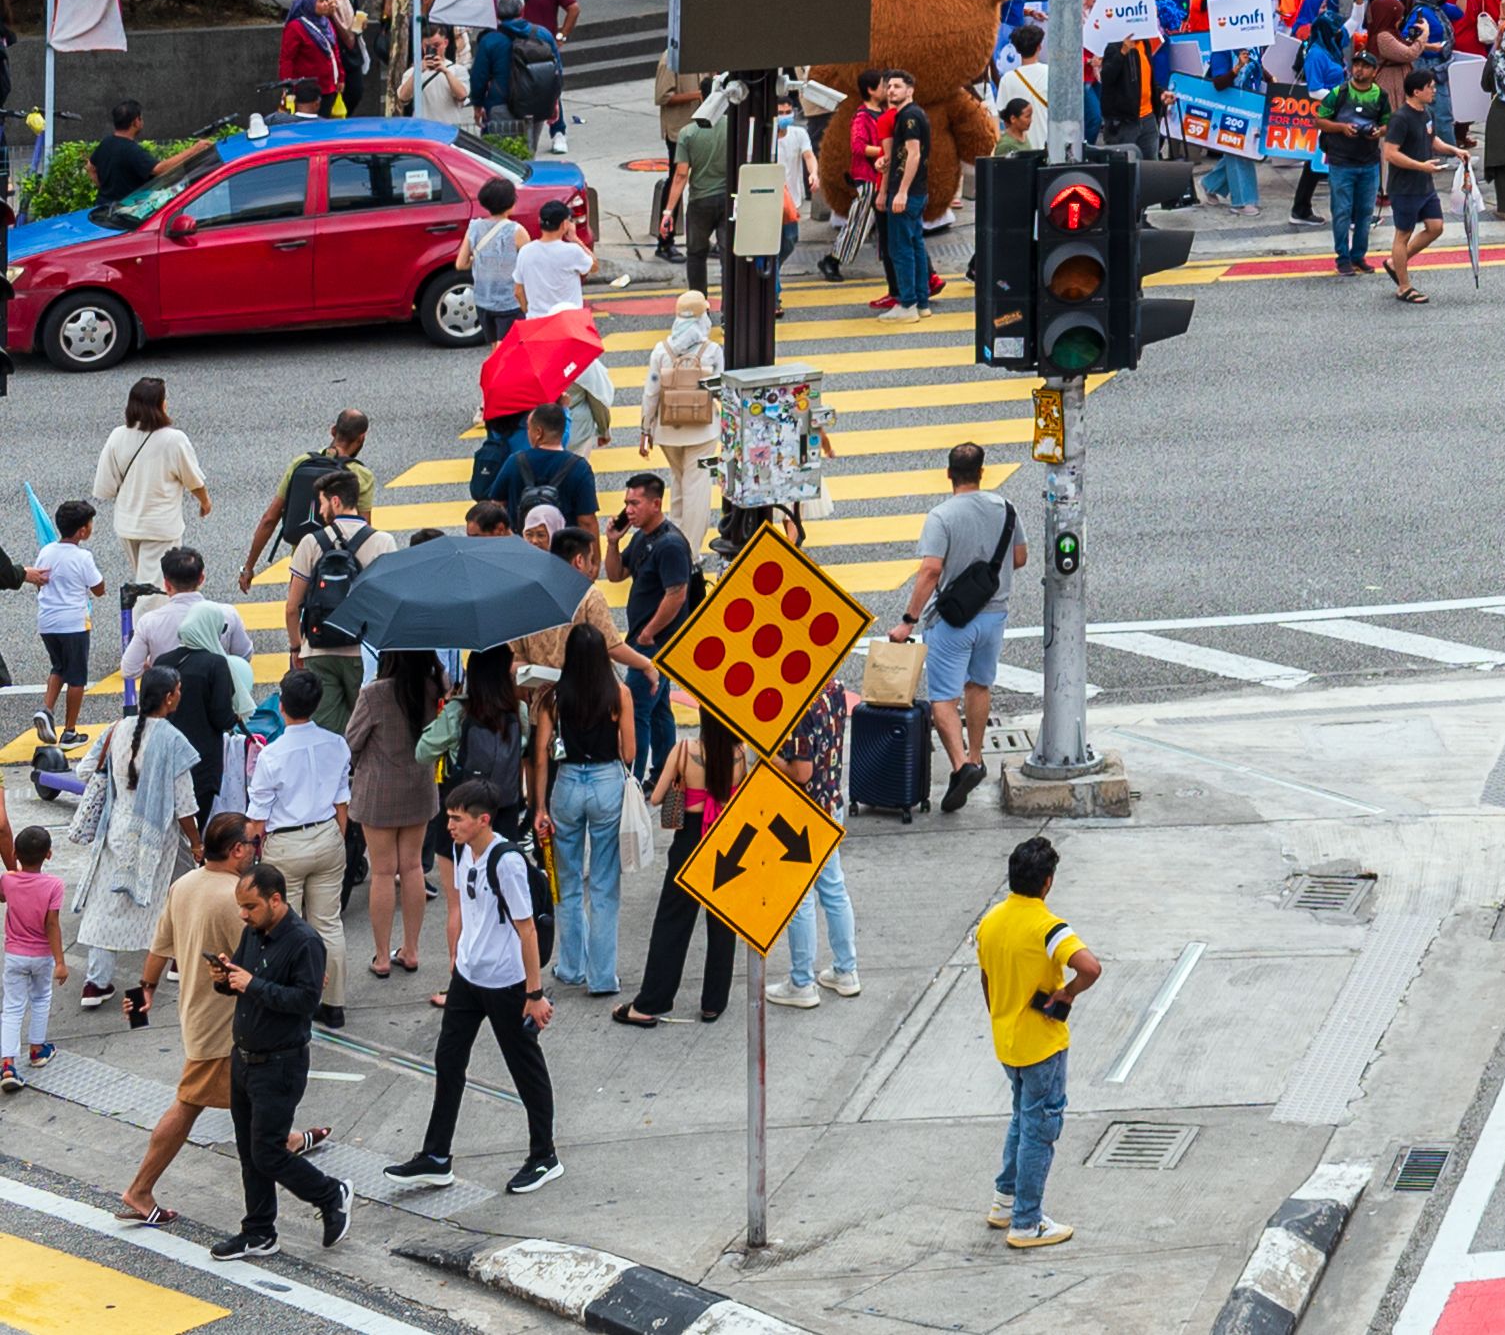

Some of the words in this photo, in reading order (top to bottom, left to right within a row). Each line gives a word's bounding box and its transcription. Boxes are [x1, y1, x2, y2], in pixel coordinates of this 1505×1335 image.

[1115, 0, 1148, 18] unifi
[1229, 5, 1264, 26] unifi
[1194, 97, 1226, 111] FREEDOM
[1224, 116, 1244, 129] 200
[1268, 114, 1290, 124] FOR
[1292, 117, 1317, 127] ONL
[1187, 124, 1204, 136] 39
[1220, 135, 1241, 147] RM1
[1266, 125, 1319, 153] RM
